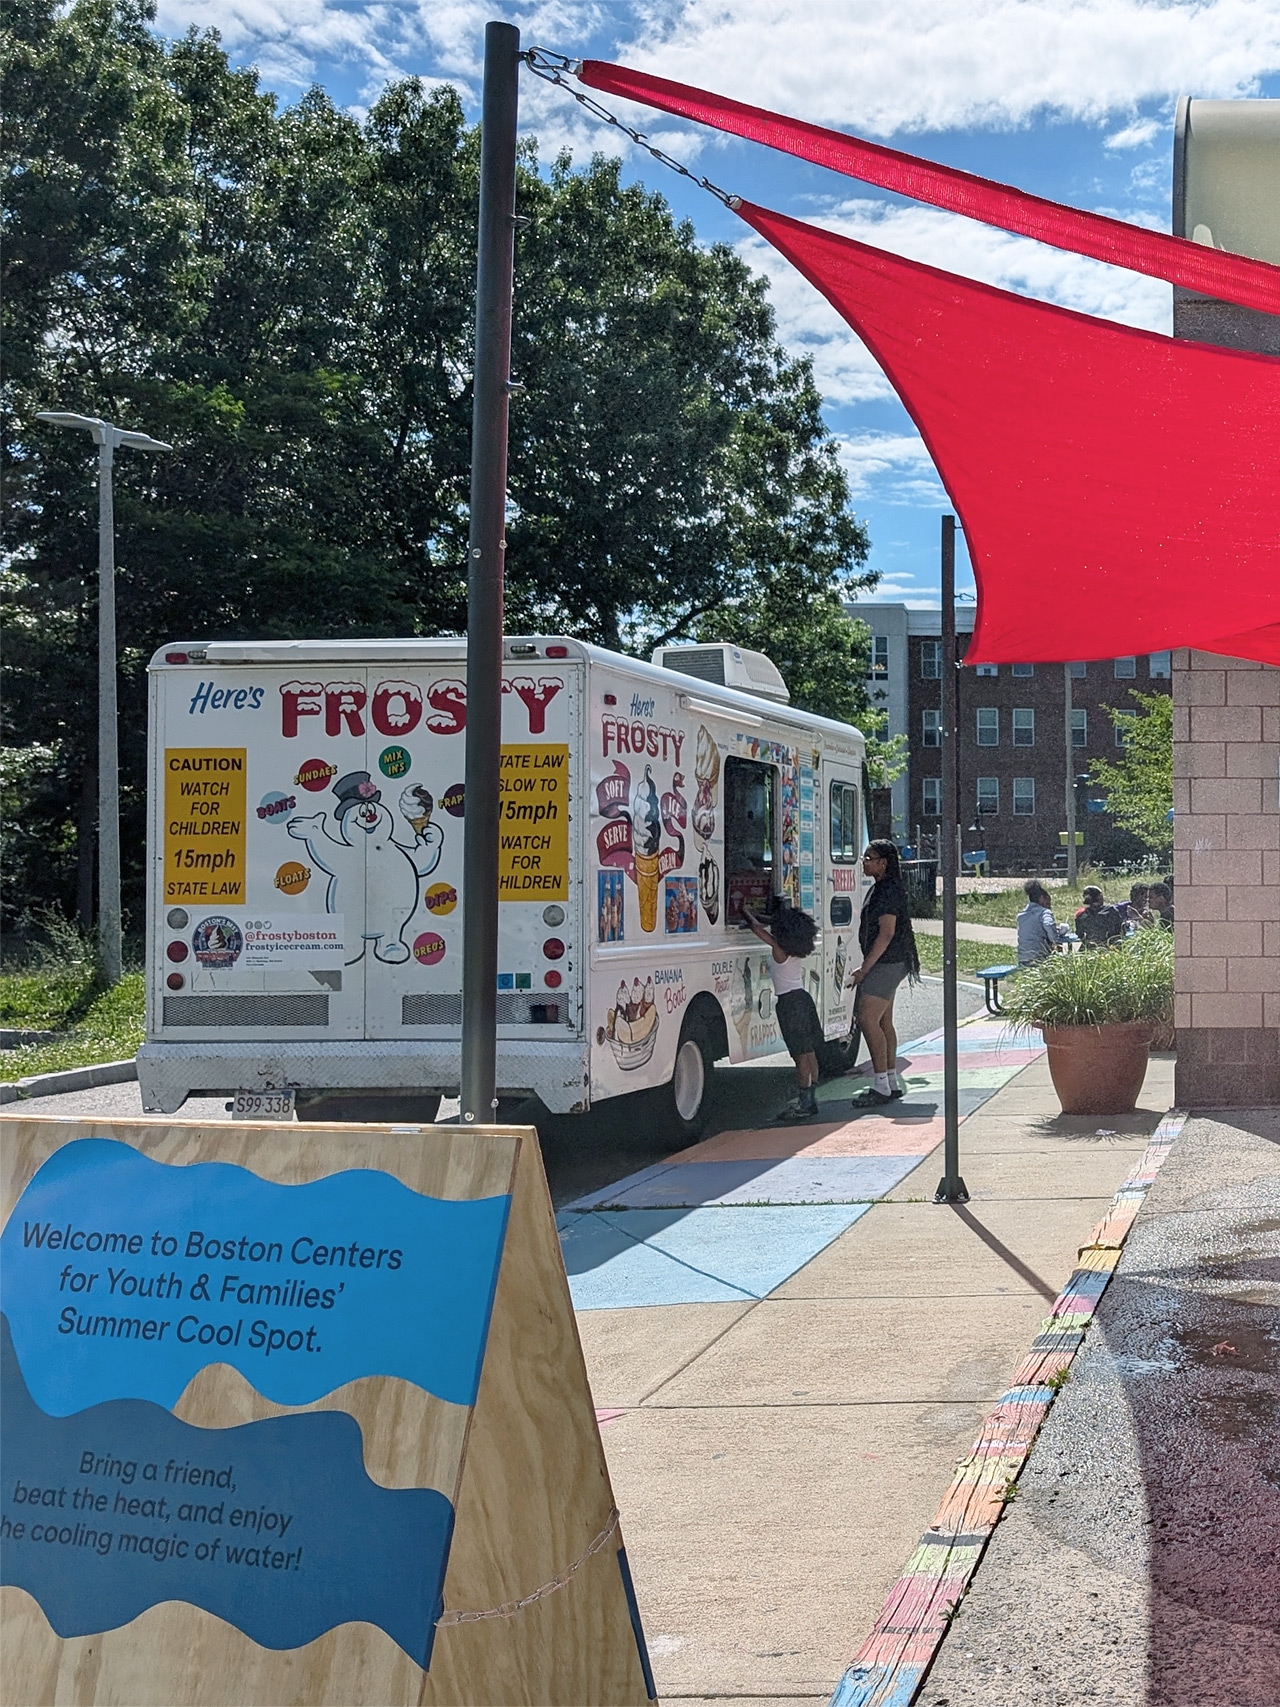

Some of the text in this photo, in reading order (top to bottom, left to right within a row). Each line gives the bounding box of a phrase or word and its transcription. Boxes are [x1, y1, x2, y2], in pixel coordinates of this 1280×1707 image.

[189, 677, 564, 738] Here's FROSY
[630, 693, 656, 717] Here's
[601, 713, 685, 768] FROSTY
[169, 758, 242, 771] CAUTION
[384, 750, 403, 764] MIX
[500, 755, 564, 768] TATE LAW
[293, 765, 338, 786] SUNDAES
[500, 778, 558, 792] SLOW TO
[180, 782, 230, 796] WATCH
[605, 780, 625, 800] SOFT
[190, 802, 220, 815] FOR
[256, 795, 297, 819] BOATS
[437, 793, 466, 810] FRAP
[499, 800, 558, 824] 15mph
[667, 796, 681, 819] ICE
[169, 821, 241, 835] CHILDREN
[603, 824, 628, 849] SERVE
[501, 836, 551, 849] WATCH
[174, 849, 236, 873] 15mph
[511, 855, 541, 869] FOR
[659, 851, 677, 874] CREAM
[167, 882, 241, 895] STATE LAW
[273, 868, 312, 889] FLOATS
[500, 875, 562, 889] HILDREN
[425, 888, 457, 910] DIPS
[245, 930, 337, 942] @frostyboston
[245, 943, 344, 953] frostyicecream.com
[654, 968, 684, 985] BANANA
[711, 960, 733, 976] DOUBLE
[664, 983, 687, 1014] Boat
[22, 1221, 403, 1270] Welcome to Boston Centers
[59, 1265, 346, 1309] for Youth & Families'
[57, 1306, 323, 1356] Summer Cool Spot.
[79, 1451, 237, 1493] Bring a friend,
[13, 1480, 293, 1538] beat the heat, and enjoy
[0, 1515, 303, 1571] he cooling magic of water!
